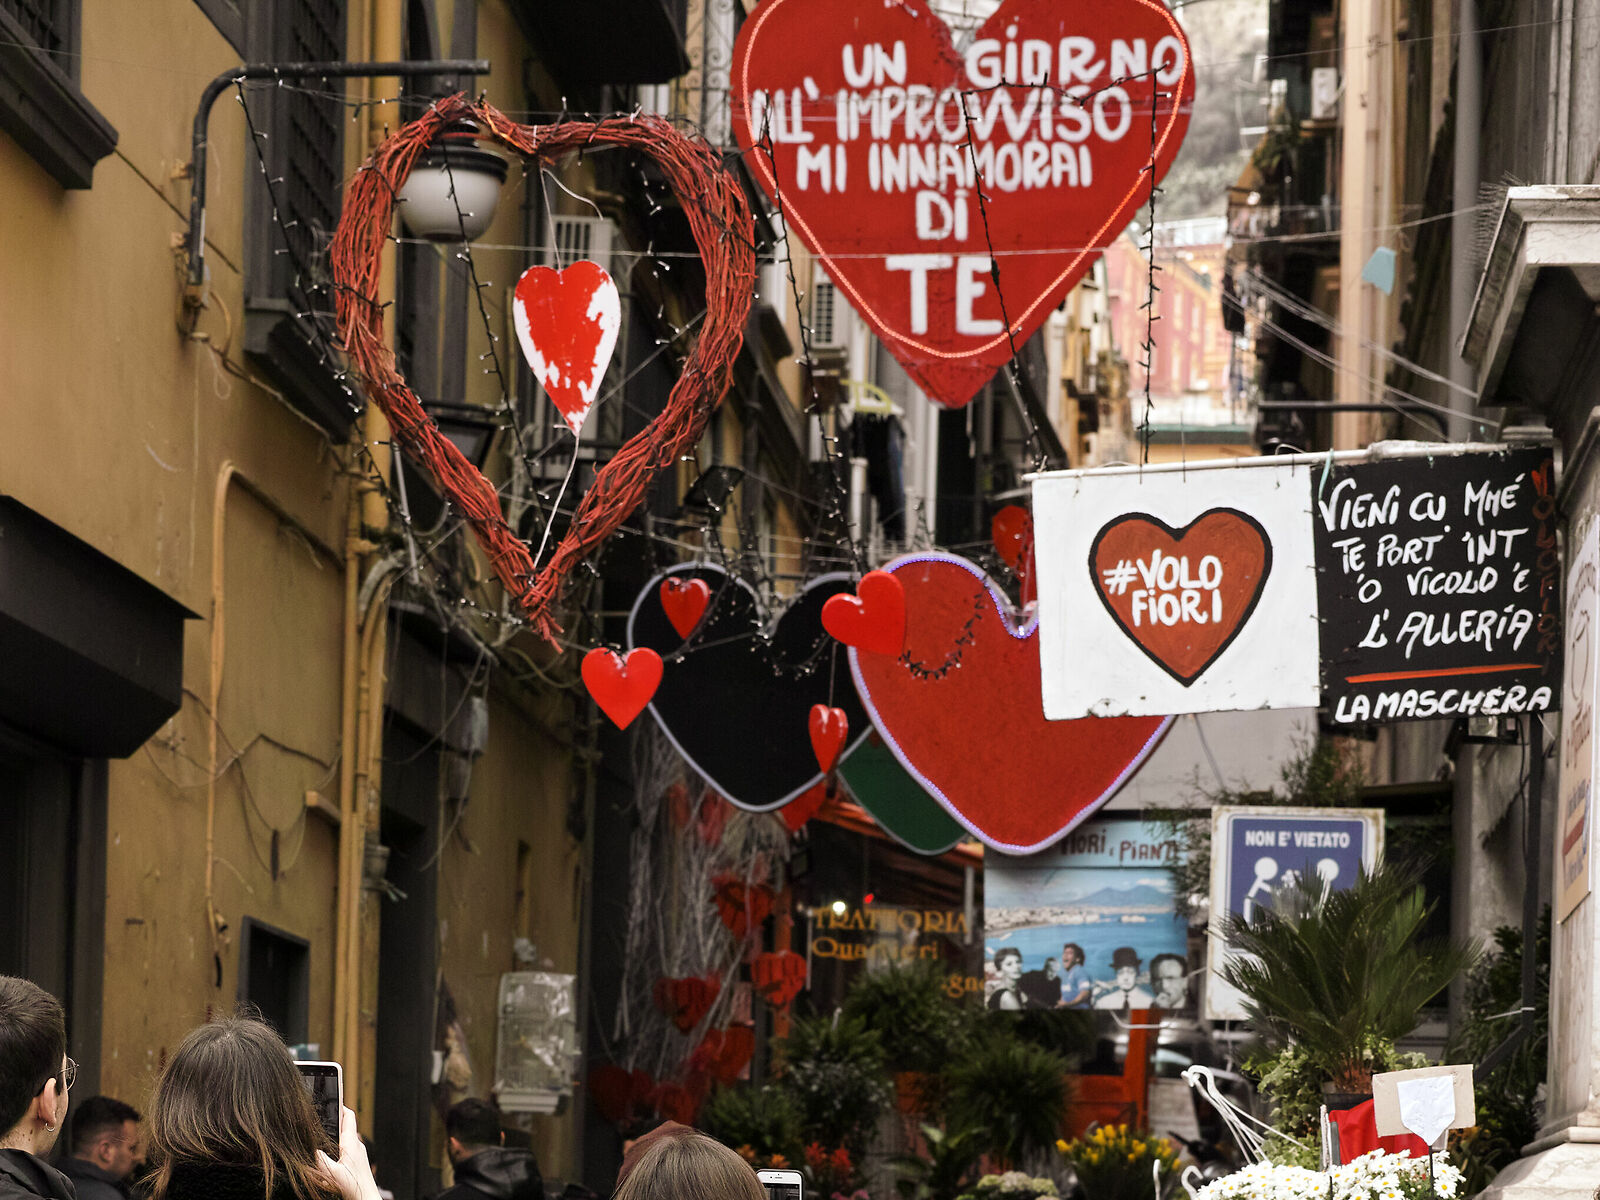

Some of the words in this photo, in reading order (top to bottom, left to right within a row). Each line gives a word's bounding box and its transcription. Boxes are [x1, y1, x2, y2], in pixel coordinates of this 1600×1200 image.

[842, 40, 907, 87] UN
[797, 143, 847, 194] MI
[868, 142, 1093, 192] INNAMORAI
[885, 253, 1006, 336] TE
[1318, 477, 1400, 532] VIENI
[1409, 492, 1447, 522] CU
[1102, 548, 1223, 596] #VOLO
[1332, 537, 1366, 575] TE
[1407, 566, 1498, 596] VICOLO
[1245, 830, 1275, 847] NON
[1278, 831, 1291, 847] E'
[1293, 831, 1351, 848] VIETATO
